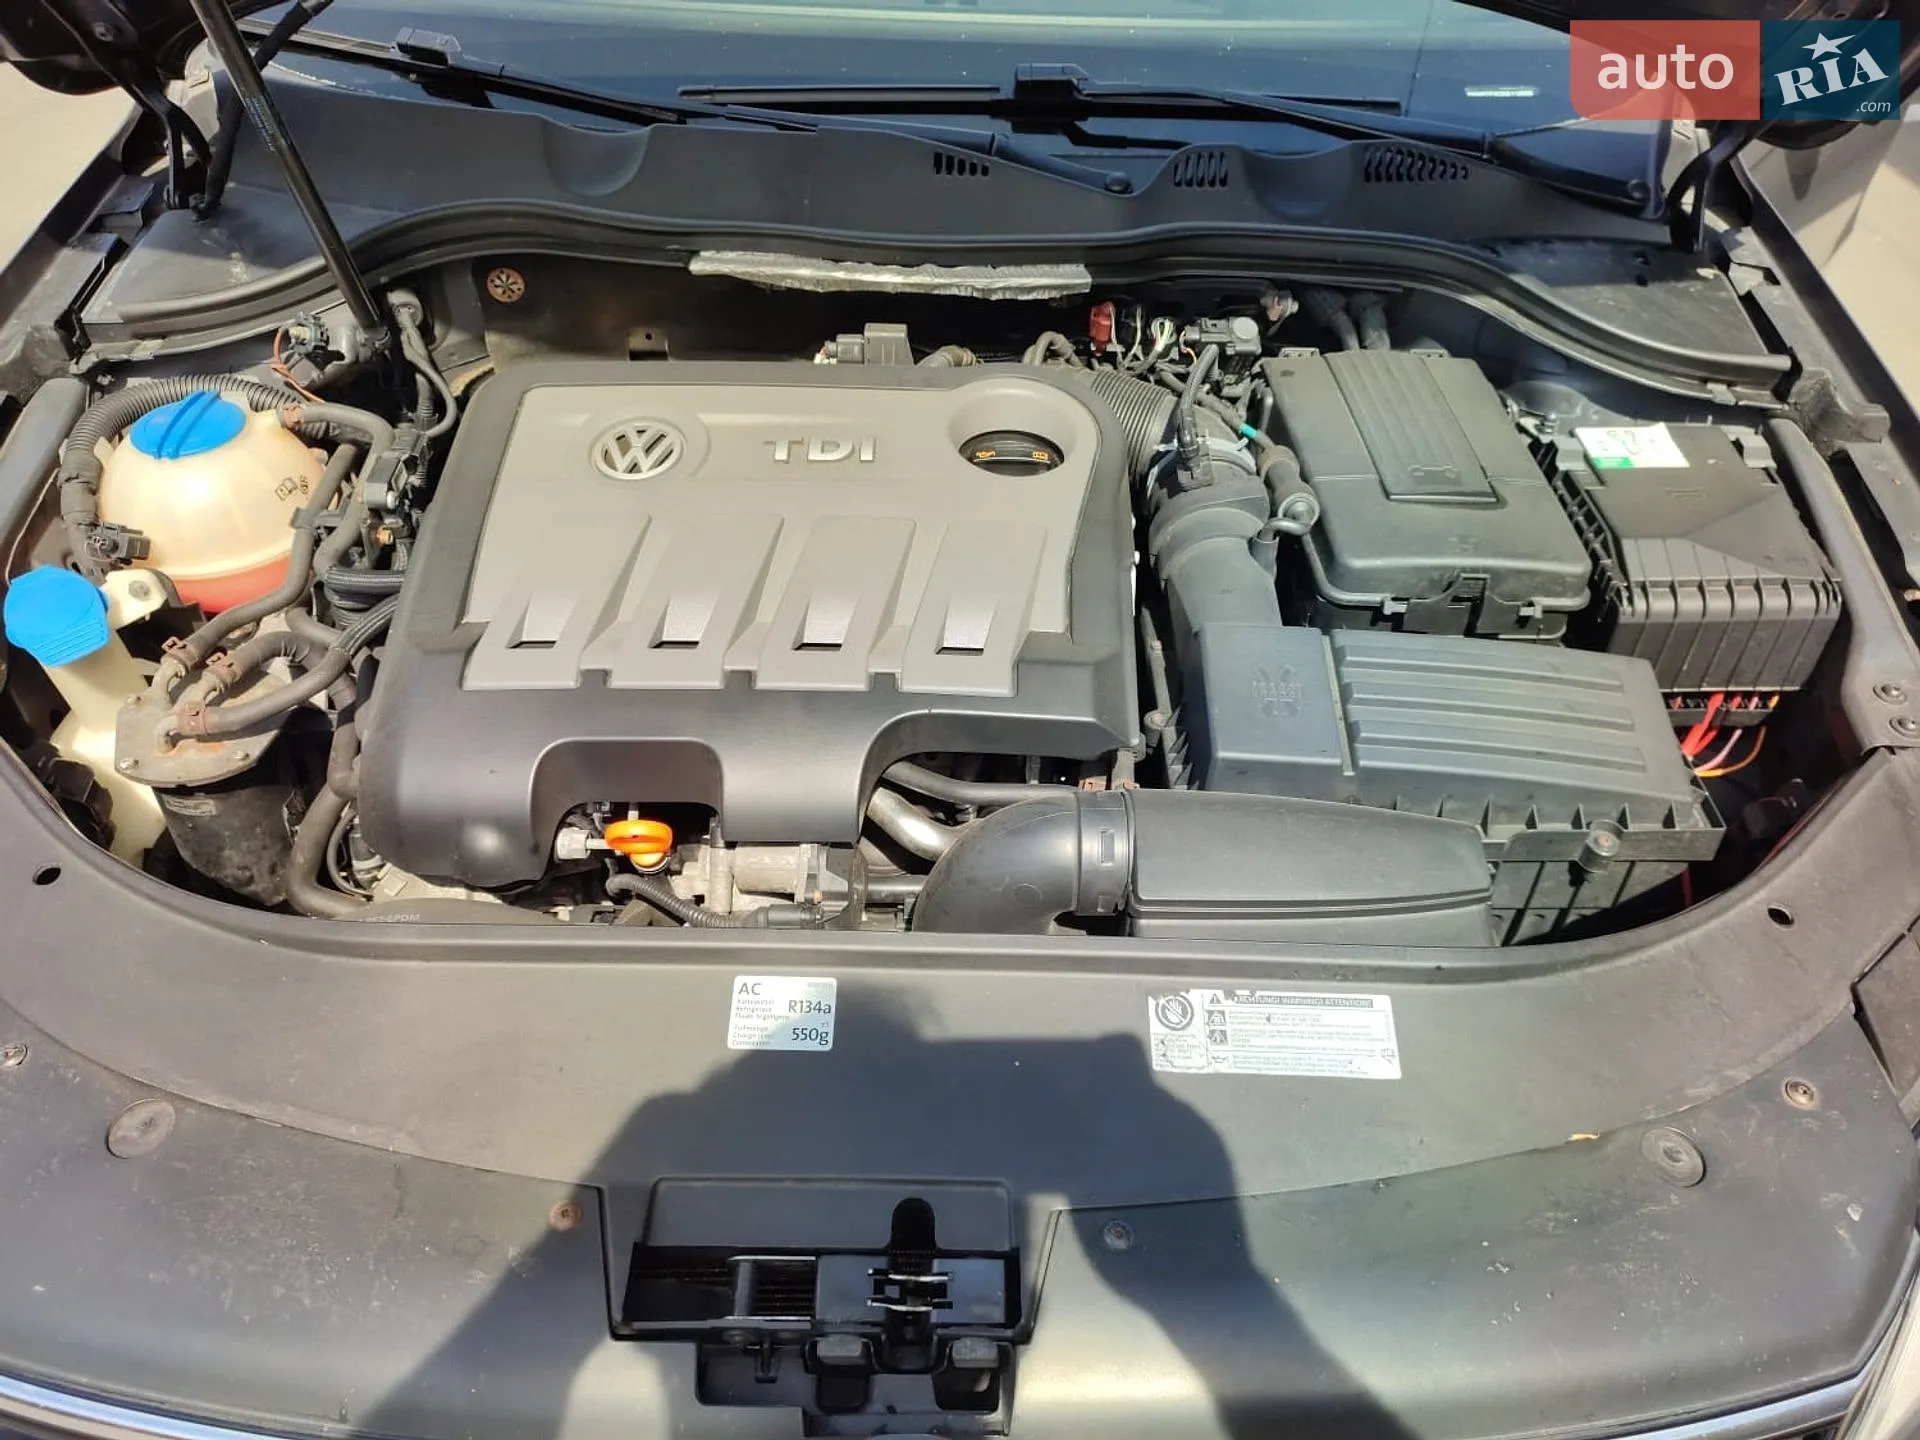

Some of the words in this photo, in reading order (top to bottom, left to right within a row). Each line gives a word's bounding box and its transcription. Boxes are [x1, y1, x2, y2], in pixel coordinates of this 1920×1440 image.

[763, 435, 878, 464] TDI
[738, 982, 763, 996] AC
[788, 999, 832, 1014] R134a
[791, 1027, 830, 1046] 550g
